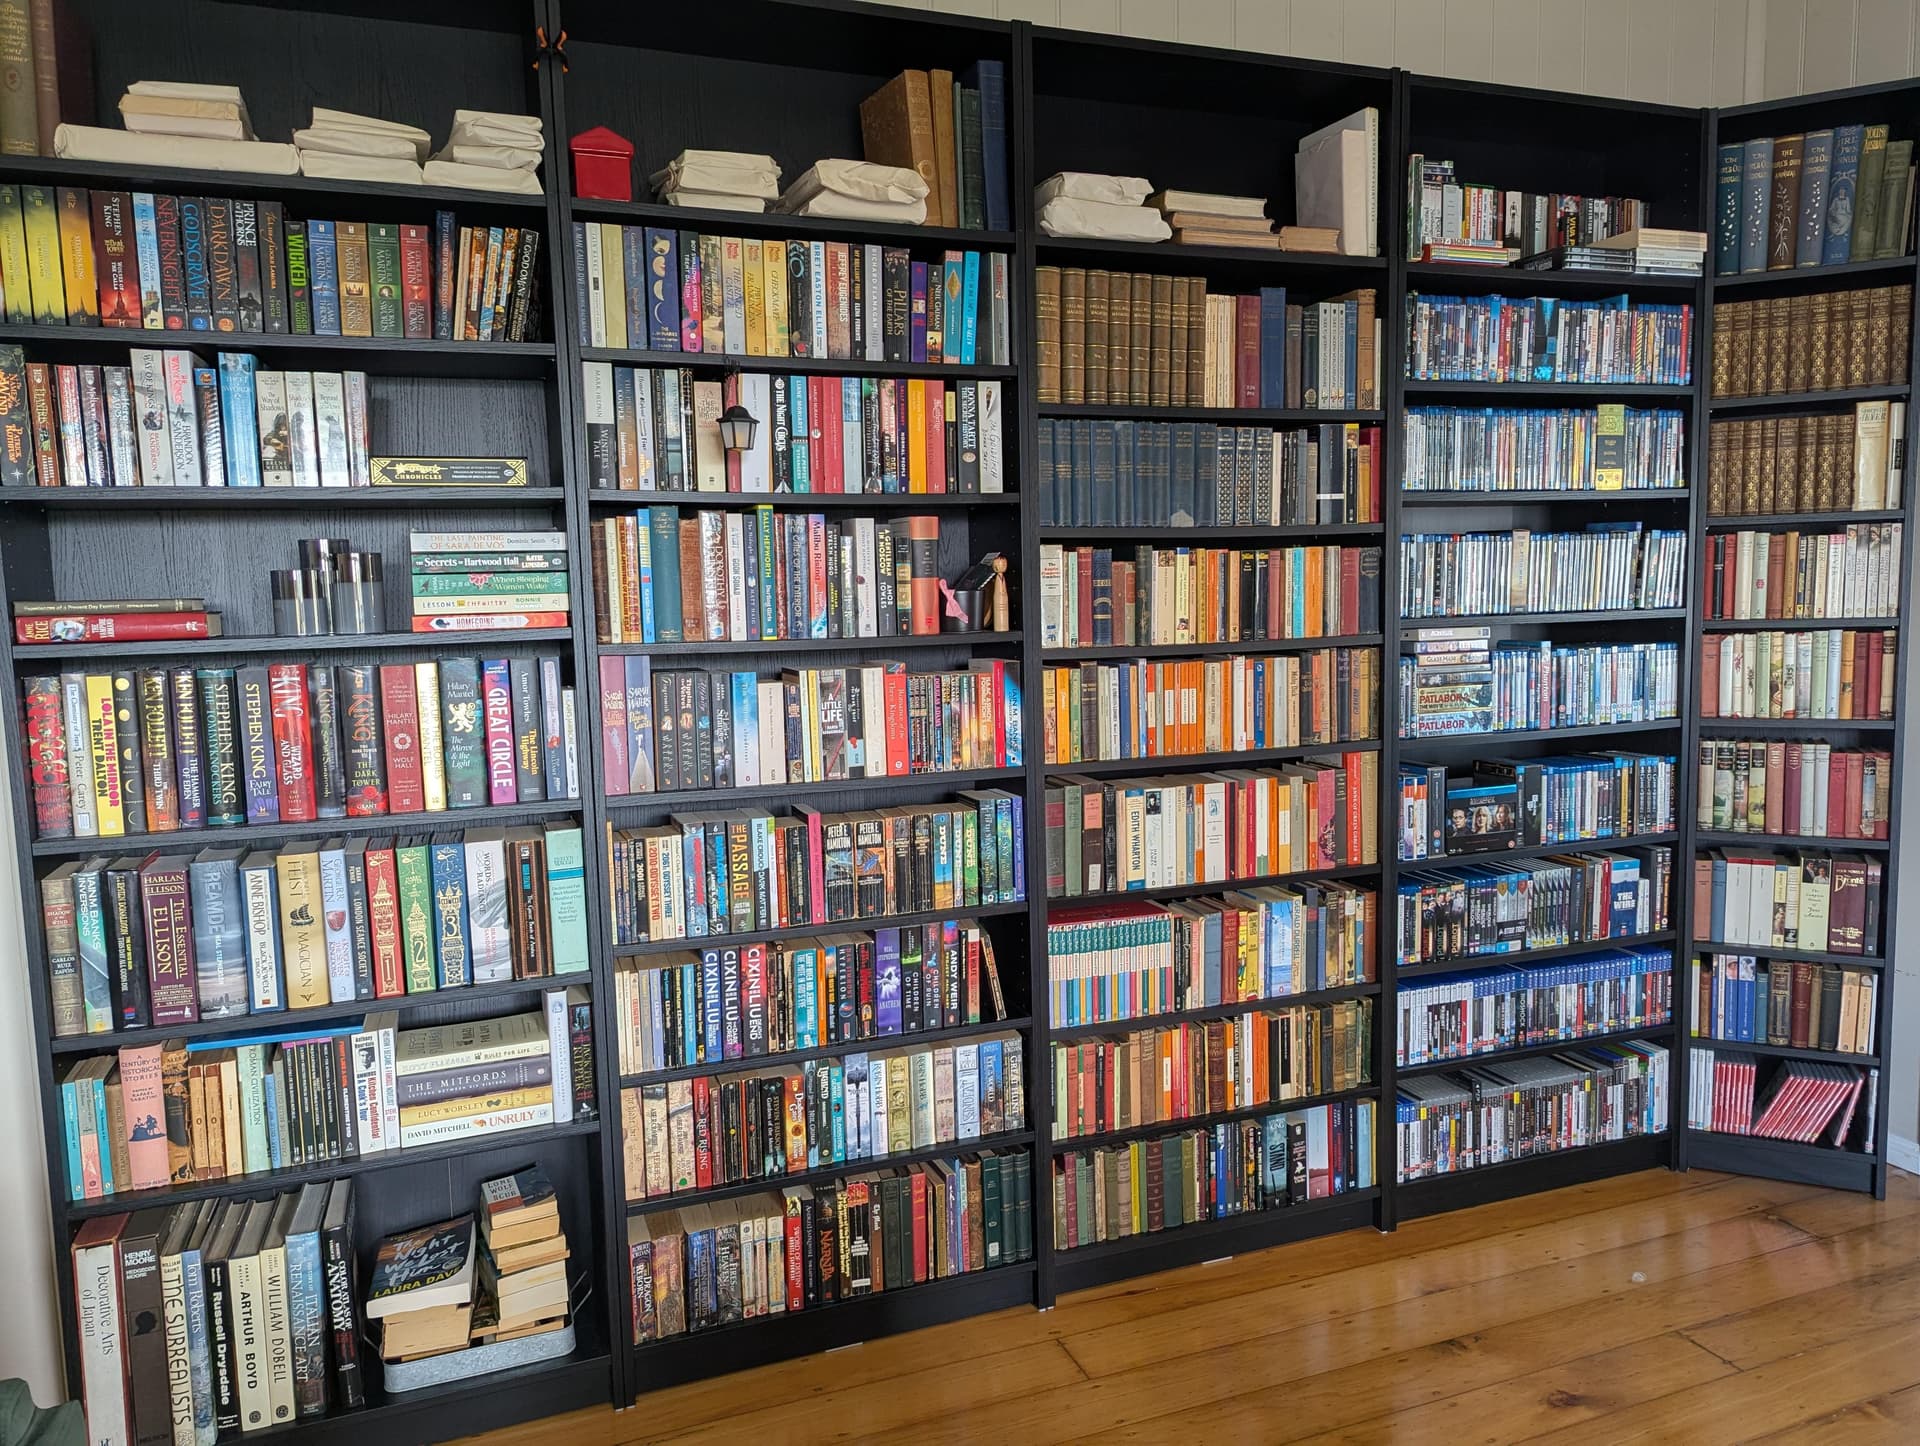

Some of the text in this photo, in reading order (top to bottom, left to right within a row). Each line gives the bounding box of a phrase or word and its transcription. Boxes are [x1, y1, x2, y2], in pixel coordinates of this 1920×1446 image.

[104, 205, 112, 228] KING
[112, 197, 121, 236] STEPHEN
[244, 203, 256, 247] PRINCE
[157, 198, 180, 300] NEVERNIGHT
[183, 203, 206, 299] GODSGRAVE
[209, 206, 232, 301] DARKDAWN
[287, 235, 307, 287] WICKED
[815, 268, 823, 300] EASTON
[815, 303, 823, 336] ELLIS
[840, 284, 848, 323] EUGENIDES
[894, 290, 907, 336] PILLARS
[968, 387, 977, 449] DONNA TARTT
[175, 421, 184, 470] SANDERSON
[813, 521, 821, 548] Malibu
[424, 557, 519, 567] Secrets Hartwood Hall
[732, 558, 742, 595] GOON SQUAD
[35, 620, 49, 640] RICE
[447, 683, 470, 691] Hilary
[448, 690, 474, 698] Mantel
[821, 701, 842, 710] LITTLE
[1420, 693, 1461, 704] PATLABOR
[522, 694, 530, 722] Towles
[821, 709, 843, 723] LIFE
[1420, 720, 1465, 731] PATLABOR
[215, 683, 236, 805] STEPHEN KING
[246, 683, 266, 779] STEPHEN KING
[488, 688, 512, 788] GREAT CIRCLE
[91, 719, 108, 797] TRENT DALTON
[101, 698, 121, 807] LOLA IN THE MIRROR
[352, 778, 381, 787] TOWER
[731, 825, 746, 833] THE
[826, 837, 851, 849] HAMILTON
[858, 832, 882, 845] HAMILTON
[1131, 811, 1140, 870] EDITH WHARTON
[143, 875, 184, 884] HARLAN
[731, 835, 749, 899] PASSAGE
[78, 876, 90, 937] INVERSIONS
[144, 885, 185, 893] ELLISON
[250, 873, 266, 935] ANNE BISHOP
[1614, 900, 1636, 910] WIRE
[1617, 892, 1632, 900] THE
[153, 906, 172, 975] ELLISON
[354, 898, 368, 978] LONDON SEANCE SOCIETY
[446, 916, 456, 936] 3
[1436, 926, 1444, 958] POIROT
[1451, 924, 1459, 955] POIROT
[297, 932, 312, 988] MAGICIAN
[415, 940, 424, 962] 2
[705, 953, 719, 1023] CIXIN LIU
[724, 951, 737, 1021] CIXIN LIU
[748, 949, 761, 1022] CIXIN LIU
[950, 949, 958, 1010] ANDY WEIR
[125, 1073, 159, 1082] STORIES
[407, 1071, 507, 1092] THE MITFORDS
[367, 1077, 381, 1139] Kitchen Confidential
[407, 1111, 535, 1139] DAVID MITCHELL UNRULY
[418, 1102, 483, 1118] LUCY WORSLEY
[700, 1139, 708, 1170] RISING
[1270, 1143, 1285, 1171] STAND
[124, 1249, 152, 1260] HENRY
[125, 1256, 156, 1266] MOORE
[719, 1246, 729, 1284] HEAVEN
[820, 1230, 835, 1282] NARNIA
[186, 1263, 200, 1333] Tom Roberts
[328, 1263, 346, 1332] ANATOMY
[373, 1267, 461, 1298] LAURA DAVE
[636, 1264, 644, 1299] REBORN
[643, 1276, 653, 1317] DRAGON
[83, 1290, 96, 1338] of Japan
[96, 1264, 113, 1356] Decorative Arts
[290, 1263, 308, 1382] RENAISSANCE ART
[212, 1291, 230, 1405] Russell Drysdale
[240, 1291, 258, 1389] ARTHUR BOYD
[268, 1276, 286, 1384] WILLIAM DOBELL
